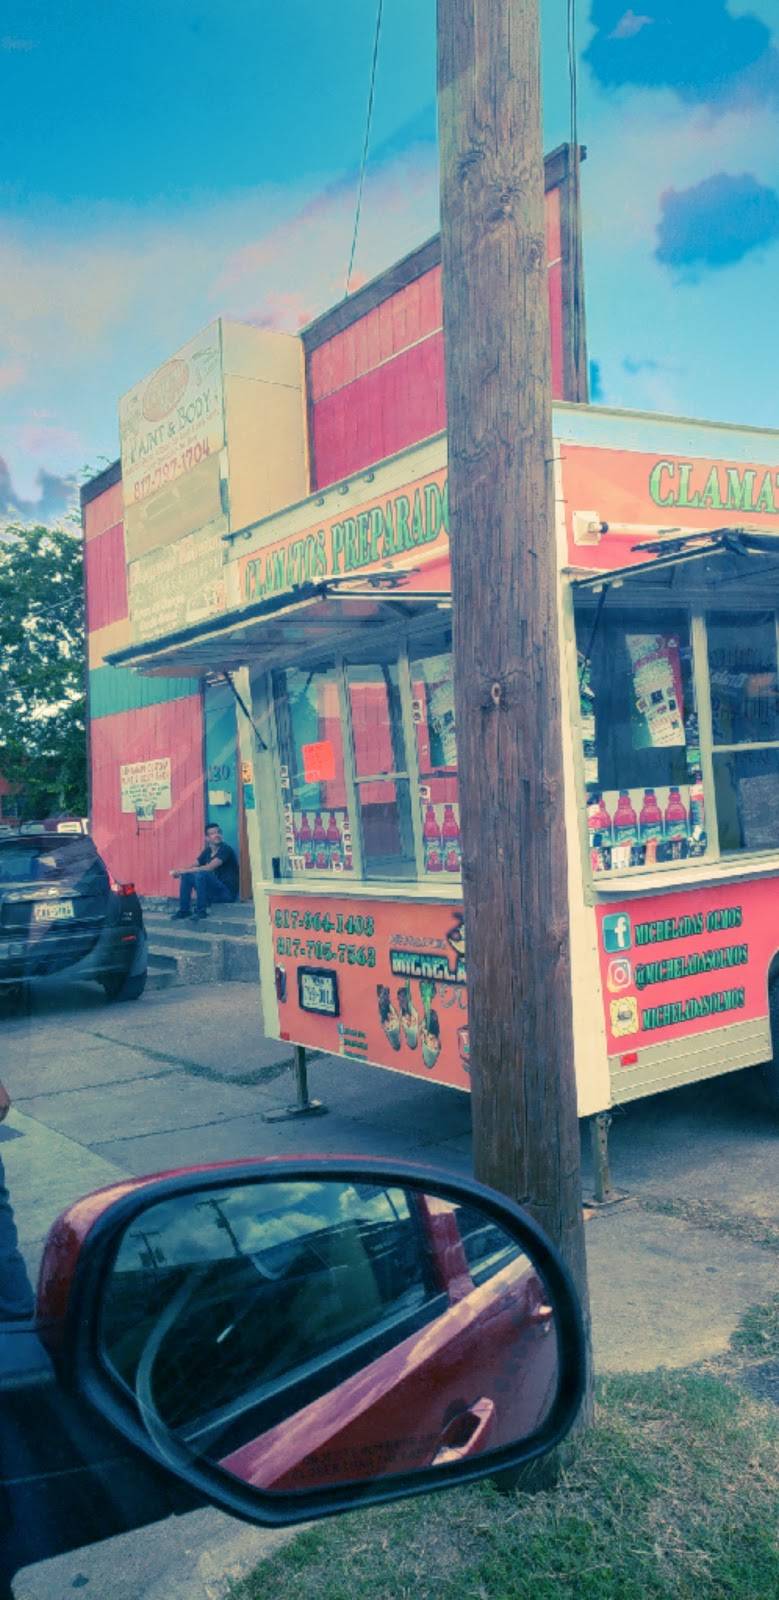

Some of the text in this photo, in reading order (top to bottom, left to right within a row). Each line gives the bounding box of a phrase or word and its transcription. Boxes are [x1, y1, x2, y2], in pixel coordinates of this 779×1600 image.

[177, 387, 210, 429] BODY
[649, 459, 779, 515] CLAMA
[245, 530, 327, 601] CLAMATOS
[634, 906, 742, 948] MICHELADAS OLMOS
